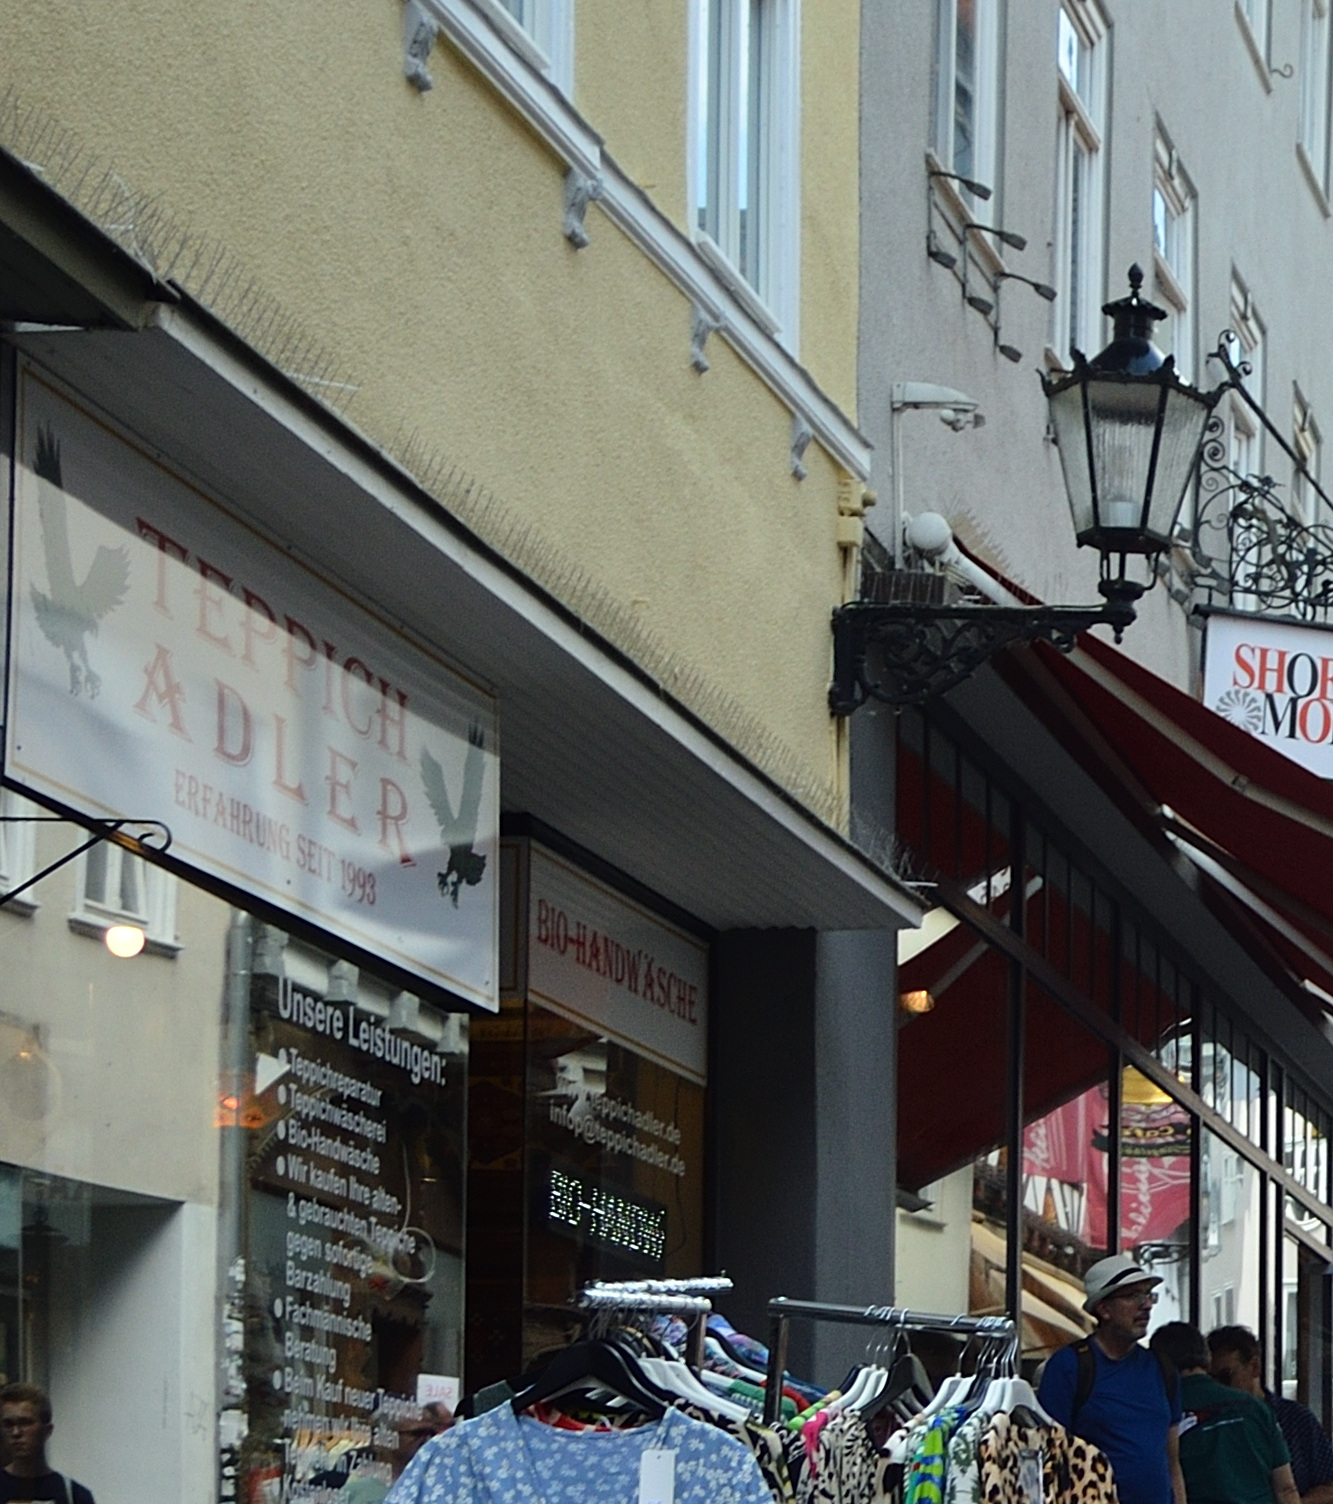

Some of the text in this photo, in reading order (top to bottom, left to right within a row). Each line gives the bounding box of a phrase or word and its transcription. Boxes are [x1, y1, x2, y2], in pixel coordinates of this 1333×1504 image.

[135, 516, 408, 765] TEPPICH
[133, 642, 417, 868] ADLER
[175, 769, 376, 905] ERFAHRUNG SEIT 1993
[537, 898, 698, 1026] BIO-HANDWÄSCHE
[278, 976, 446, 1086] Unsere Leistungen:
[289, 1048, 383, 1107] Teppichreparatur
[289, 1083, 387, 1143] Teppichwäscherei
[288, 1118, 380, 1175] Bio-Handwäsche
[288, 1153, 308, 1183] Wir
[287, 1231, 322, 1261] gegen
